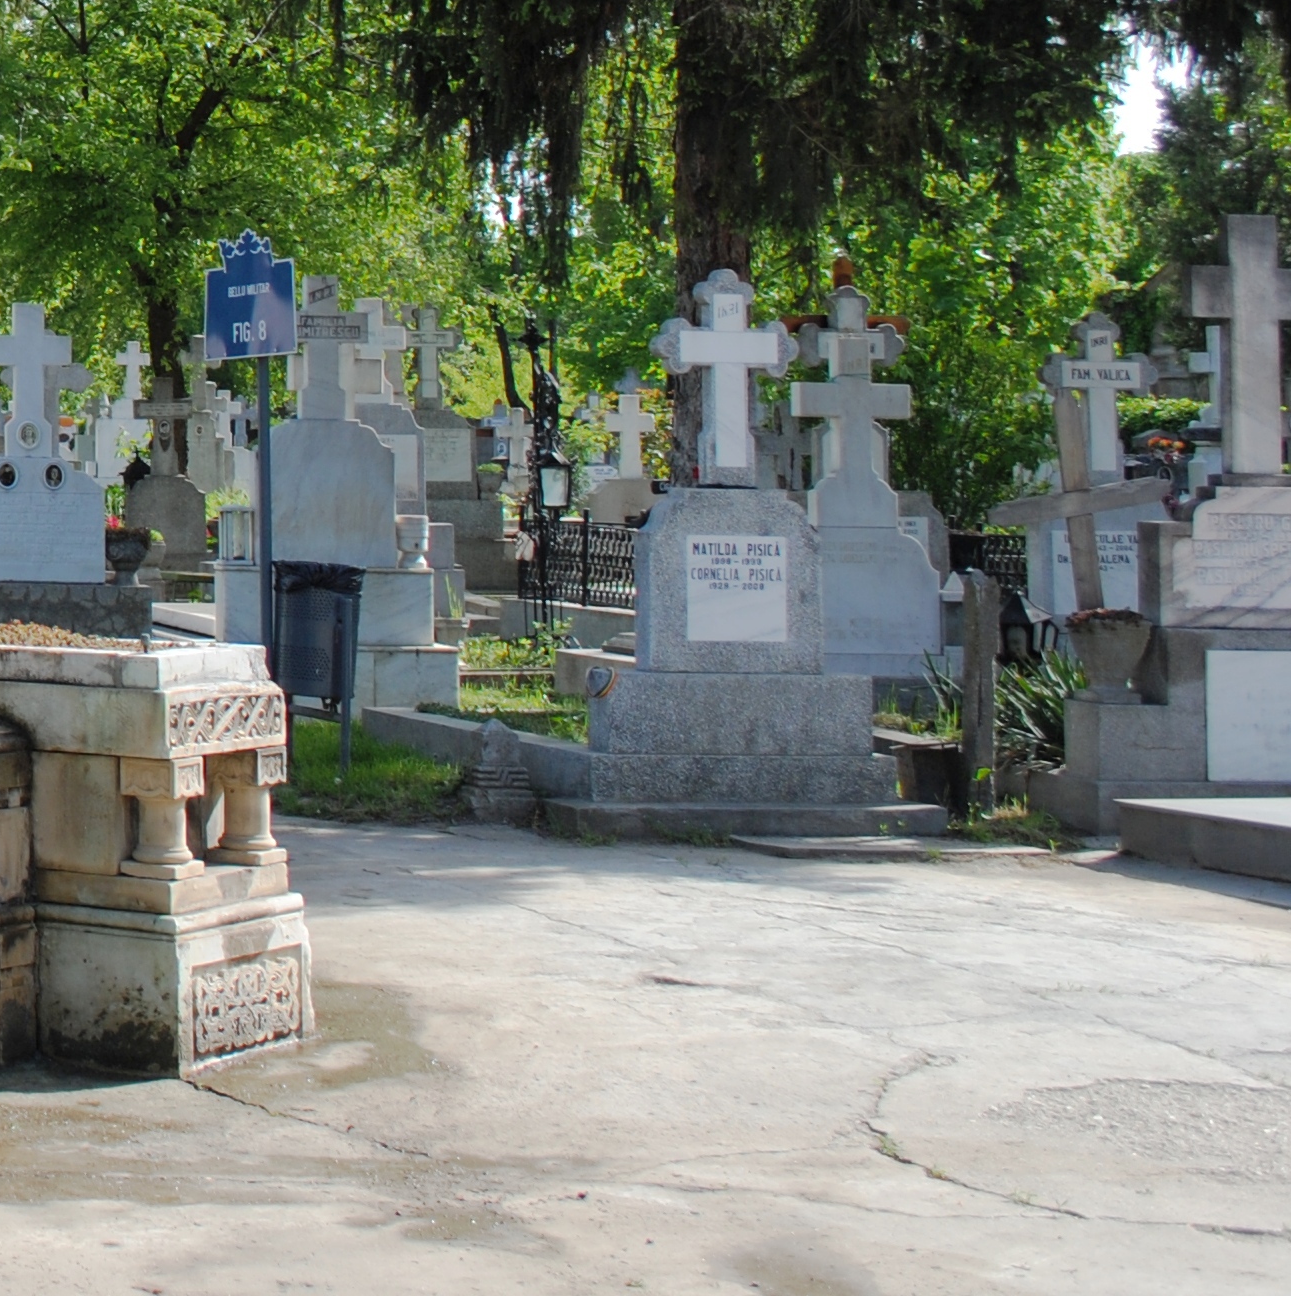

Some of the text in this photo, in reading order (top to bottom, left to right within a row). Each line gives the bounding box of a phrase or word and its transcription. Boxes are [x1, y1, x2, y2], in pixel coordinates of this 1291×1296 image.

[247, 282, 270, 296] MILITAR
[232, 319, 267, 344] FIG. 8
[1071, 368, 1131, 381] FAM. VALICA
[692, 542, 738, 556] MATILDA
[690, 567, 740, 580] CORNELIA
